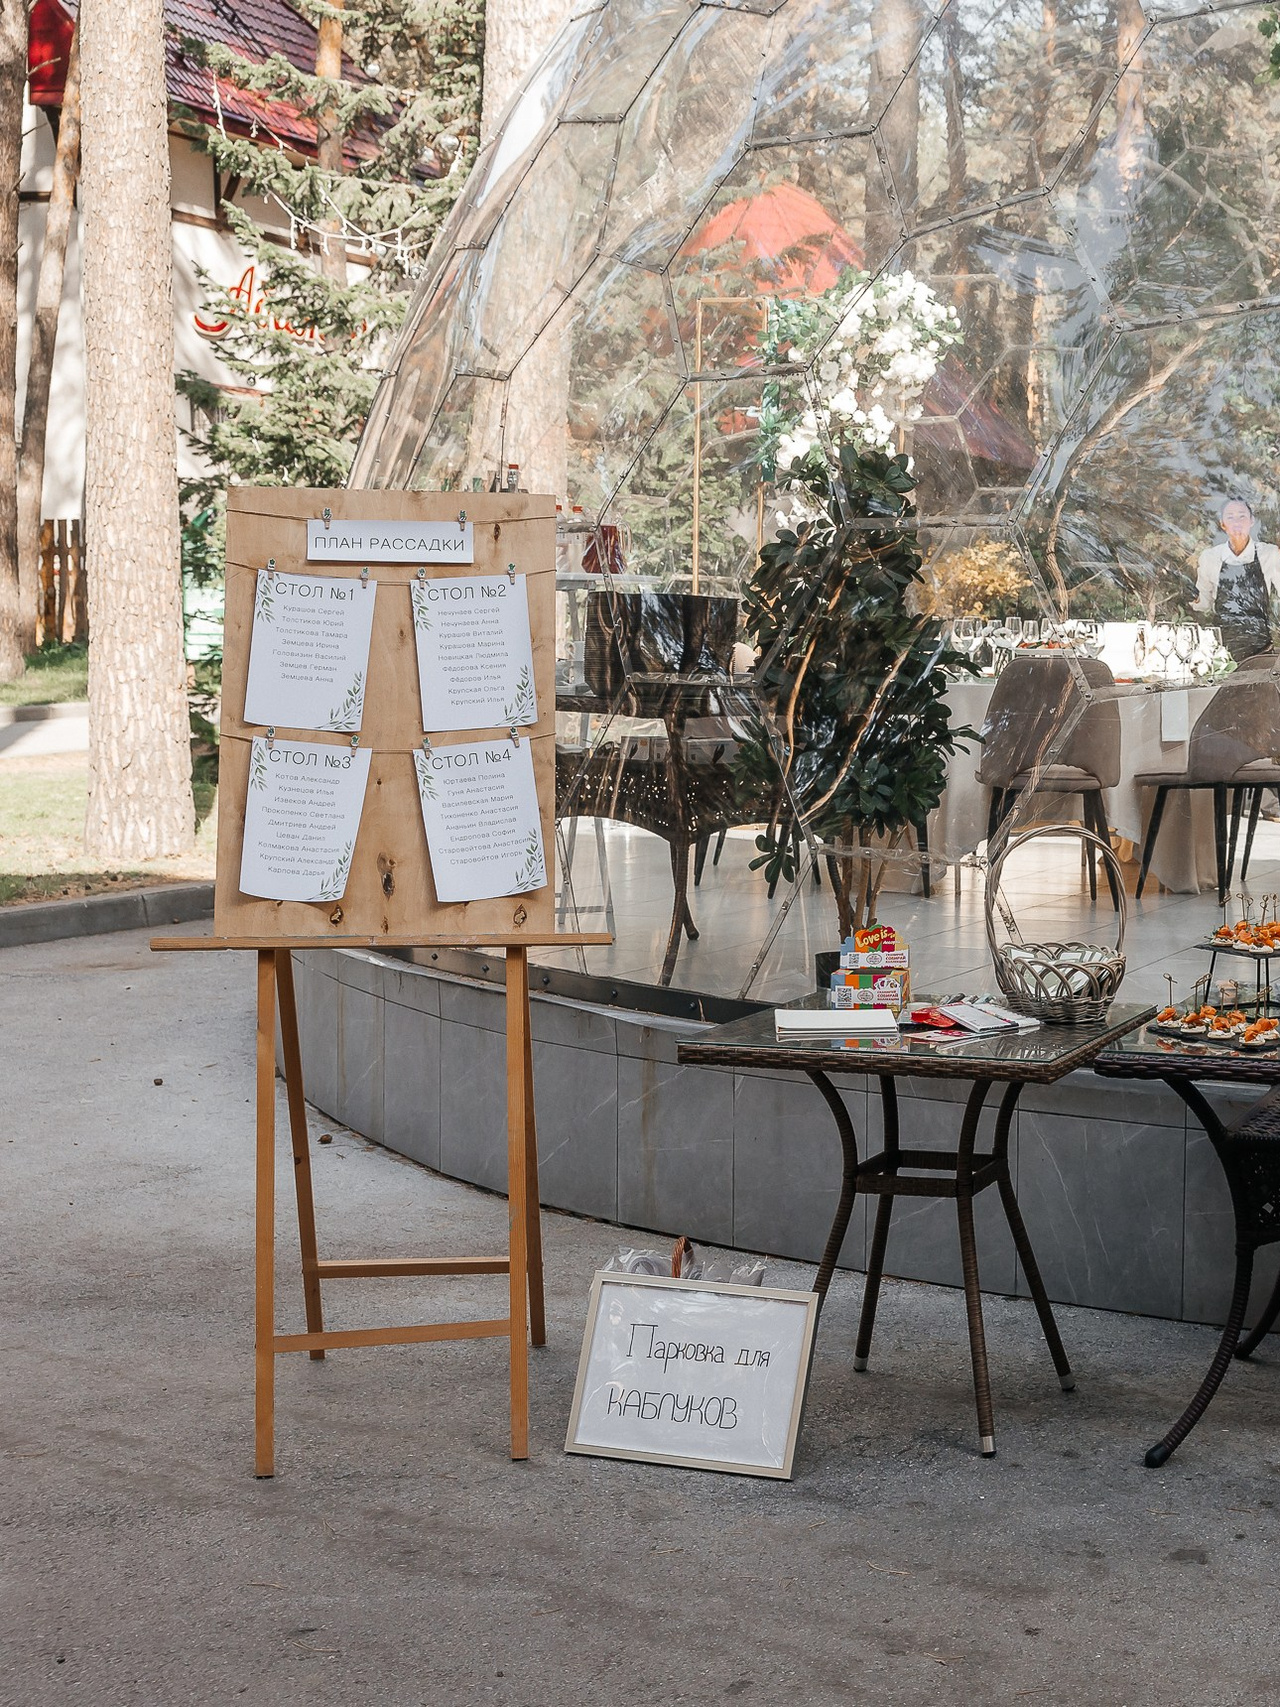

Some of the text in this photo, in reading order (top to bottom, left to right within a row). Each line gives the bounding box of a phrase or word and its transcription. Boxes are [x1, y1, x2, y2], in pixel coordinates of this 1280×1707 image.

[314, 536, 465, 552] ПЛАН РАССАДКИ
[276, 582, 323, 598] СТОЛ
[428, 584, 507, 601] СТОЛ №2
[283, 605, 345, 616] Курашов Сергей
[474, 607, 500, 616] Сергей
[282, 616, 344, 627] Толстиков Юрий
[276, 627, 348, 639] Толстикова Тамара
[281, 639, 314, 647] Земцева
[478, 640, 505, 648] Марина
[315, 653, 346, 661] Василий
[476, 651, 508, 659] Людмила
[279, 661, 338, 672] Земцев Герман
[280, 673, 334, 683] Земцева Анна
[448, 687, 482, 695] Крупская
[451, 698, 485, 706] Крупский
[269, 749, 352, 769] СТОЛ №3
[432, 749, 512, 770] СТОЛ №4
[275, 773, 340, 785] Котов Александр
[443, 772, 505, 785] Юртаева Полина
[278, 785, 314, 794] Кузнецов
[447, 784, 505, 797] Гуня Анастасия
[274, 796, 336, 808] Извеков Андрей
[442, 794, 514, 809] Василевская Мария
[261, 806, 345, 820] Прокопенко Светлана
[440, 805, 519, 820] Тихоненко Анастасия
[268, 819, 336, 831] Дмитриев Андрей
[478, 816, 517, 828] Владислав
[302, 834, 326, 842] Данил
[492, 828, 516, 837] София
[258, 841, 340, 853] Колмакова Анастасия
[438, 837, 531, 854] Старовойтова Анастасия
[259, 853, 335, 865] Крупский Александр
[450, 850, 523, 865] Старовойтов Игорь
[267, 866, 325, 876] Карпова Дарья
[855, 934, 880, 947] Love
[626, 1323, 771, 1374] Парковка для
[607, 1387, 738, 1430] КАБЛУКОВ
